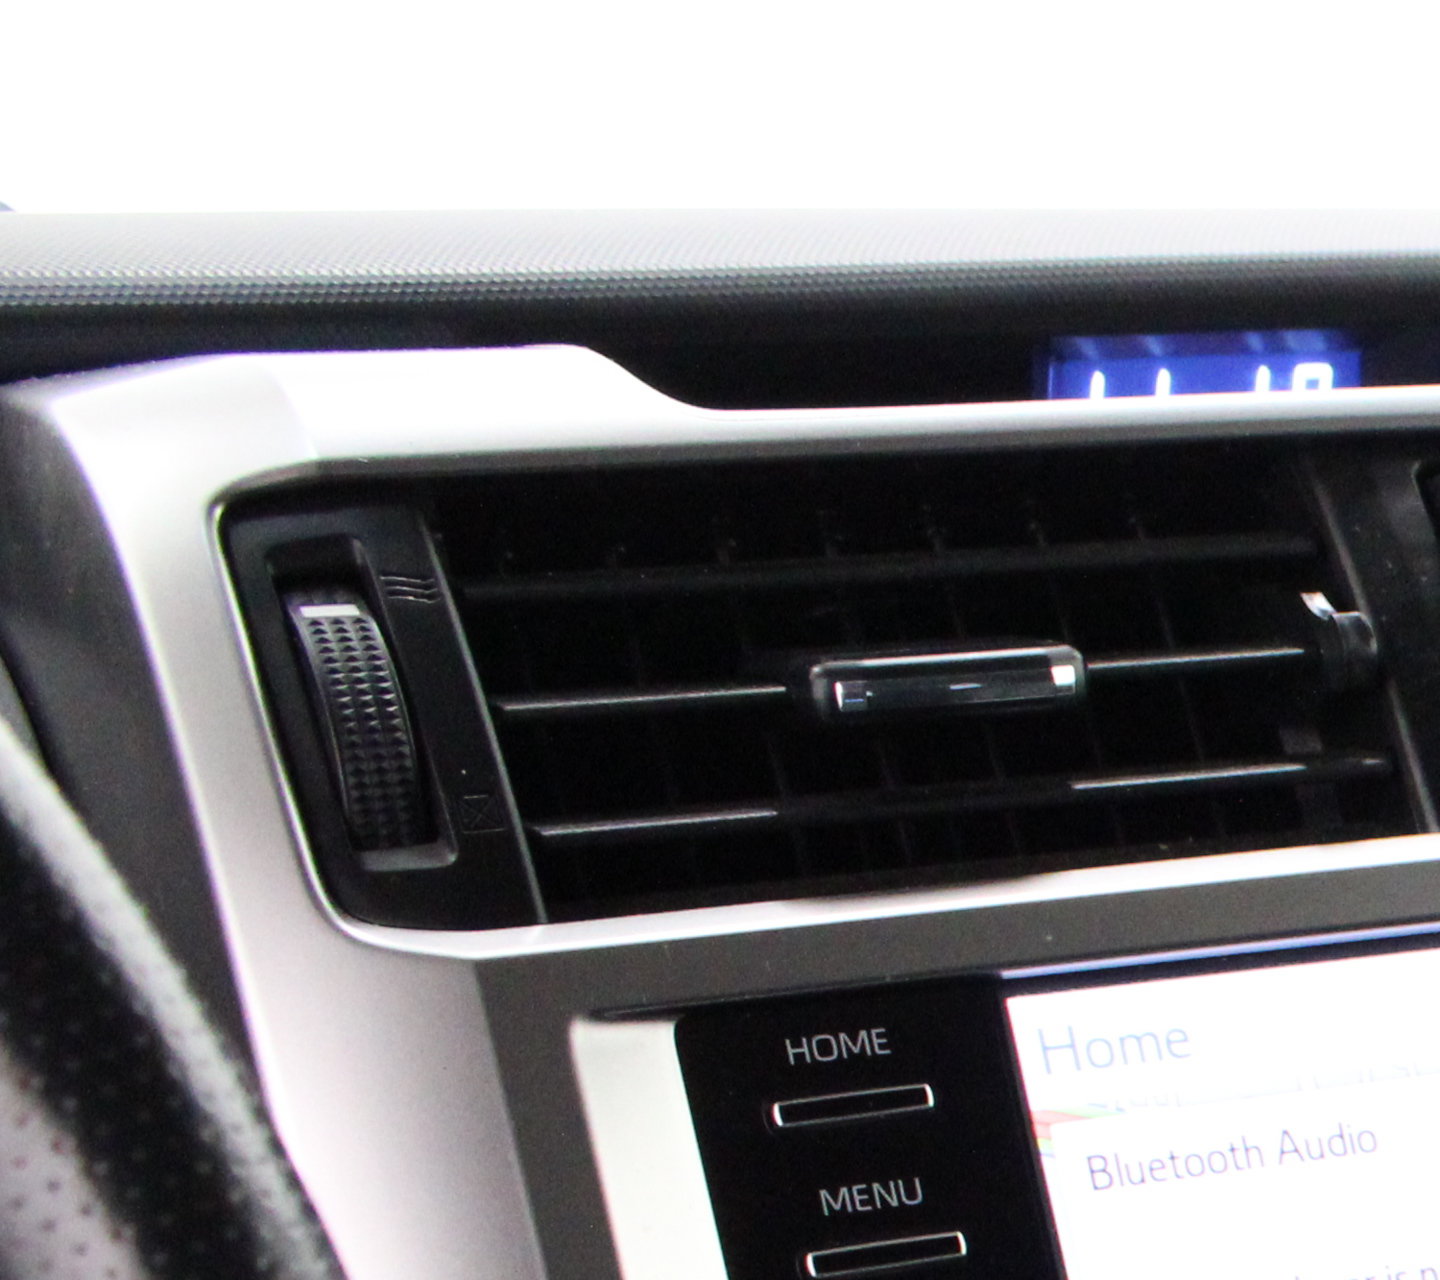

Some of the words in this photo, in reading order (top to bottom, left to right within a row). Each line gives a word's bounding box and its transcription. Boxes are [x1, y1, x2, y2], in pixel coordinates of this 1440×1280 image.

[785, 1028, 891, 1065] HOME
[1036, 1024, 1193, 1075] Home
[1087, 1136, 1265, 1192] Bluetooth
[1277, 1122, 1379, 1166] Audio
[819, 1177, 925, 1217] MENU
